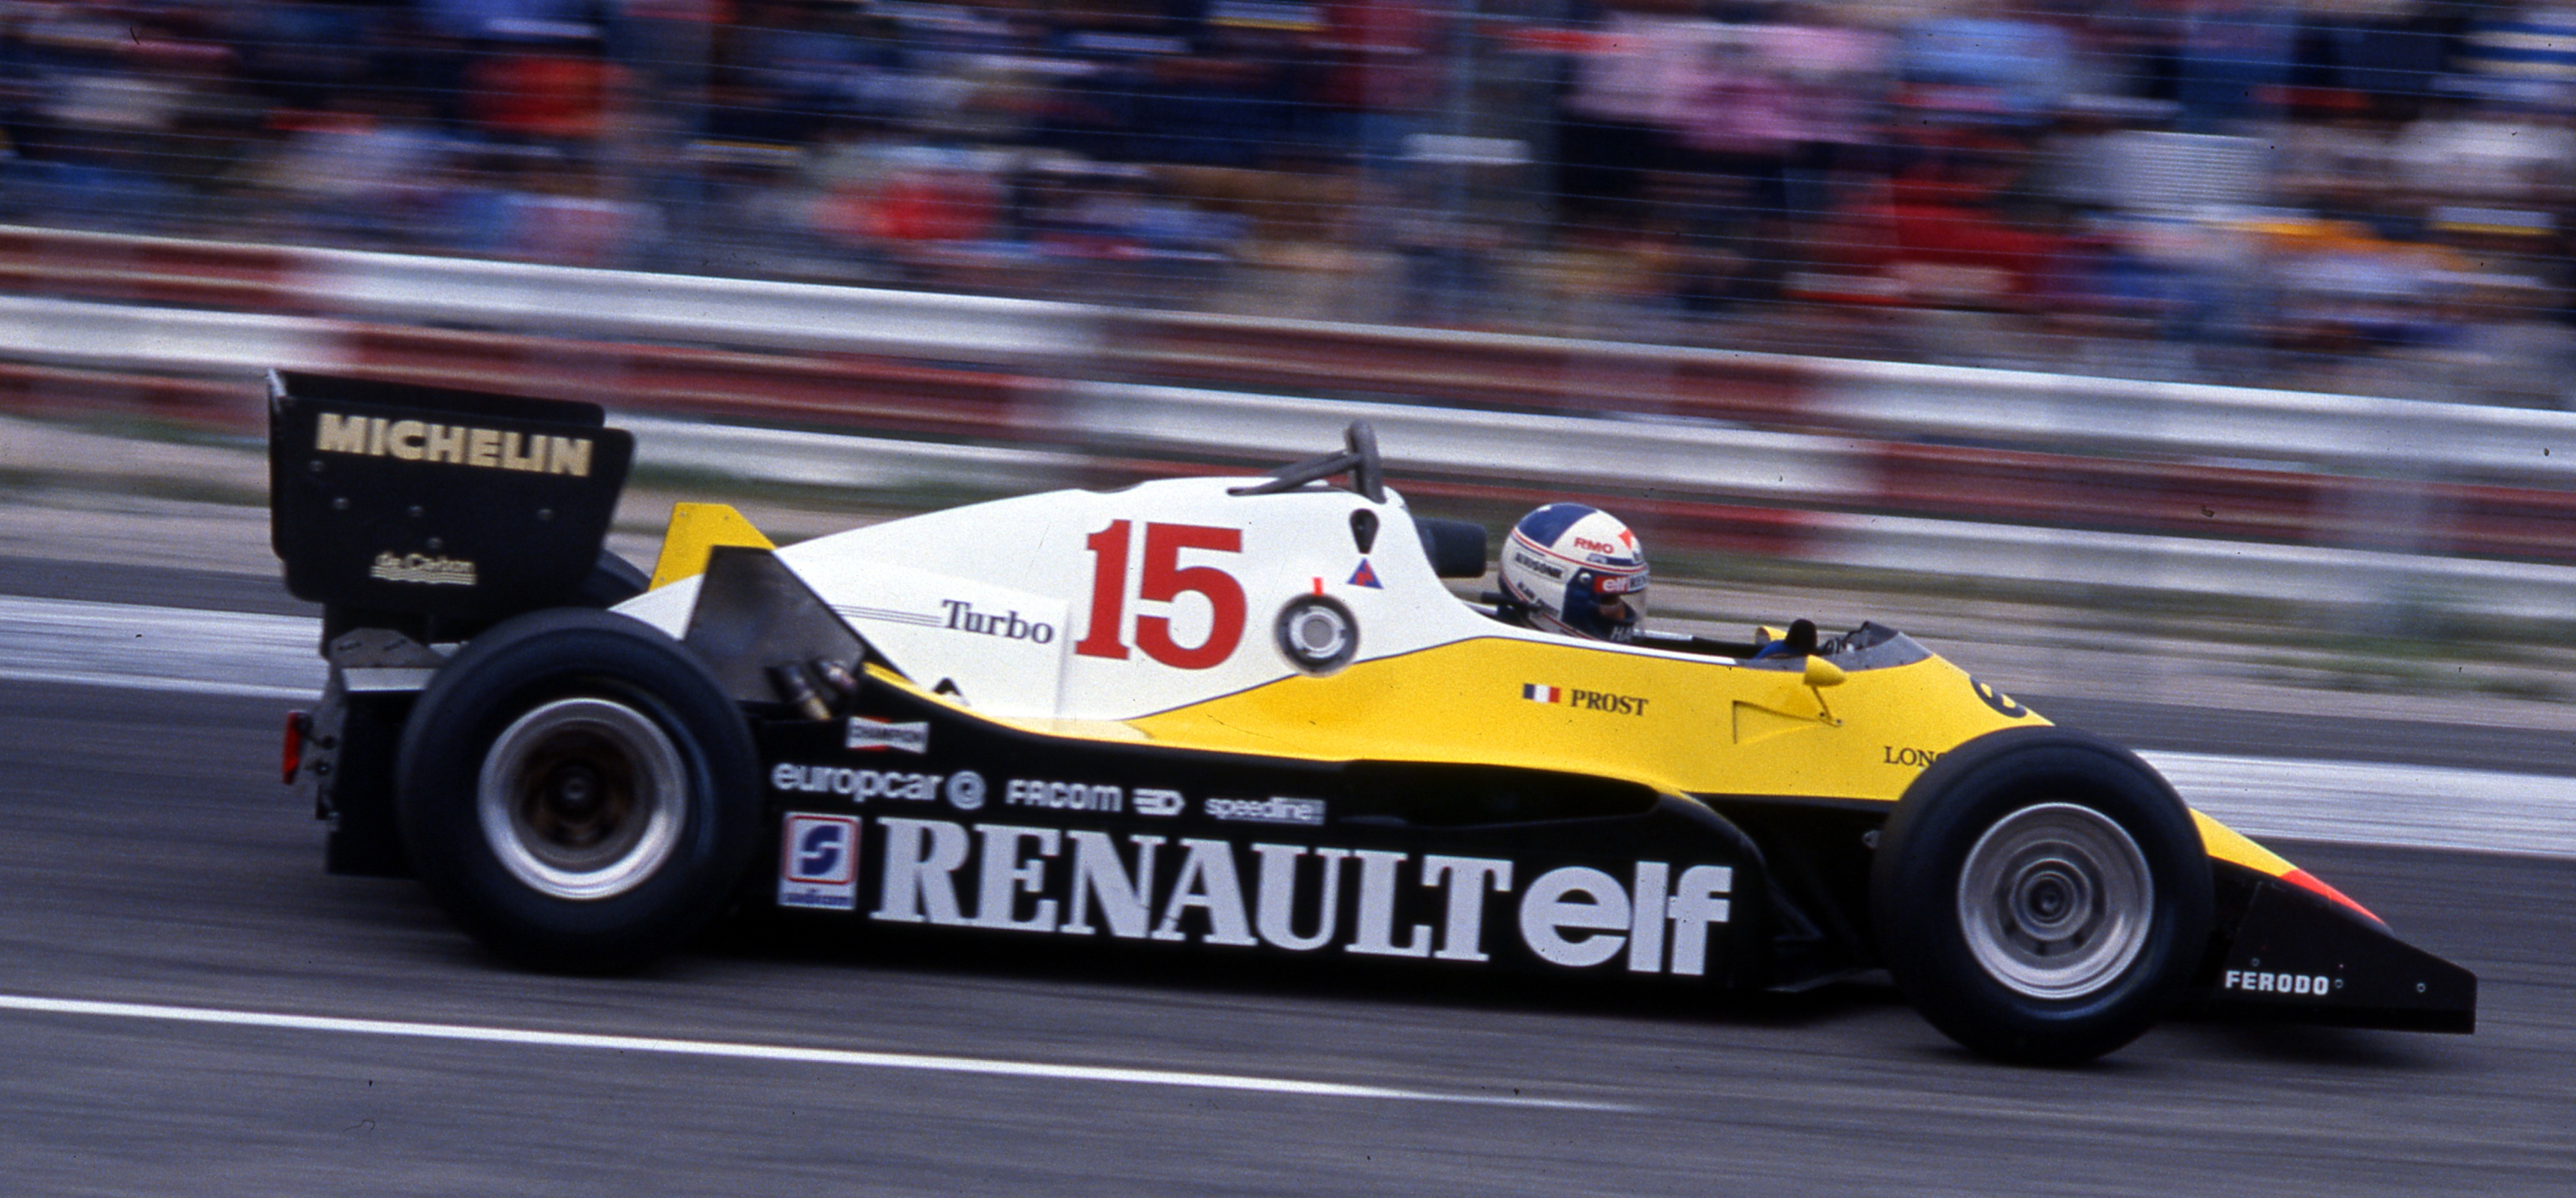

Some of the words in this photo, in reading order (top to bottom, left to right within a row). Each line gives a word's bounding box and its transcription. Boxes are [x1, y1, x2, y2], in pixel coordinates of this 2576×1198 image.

[317, 412, 594, 476] MICHELIN
[1574, 537, 1614, 554] RMO
[1076, 519, 1247, 670] 15
[1602, 577, 1629, 592] elf
[942, 599, 1054, 644] Turbo
[1571, 689, 1649, 716] PROST
[771, 763, 944, 803] europcar
[1006, 779, 1123, 812] FACOM
[1205, 797, 1320, 823] speedline
[869, 816, 1514, 962] RENAULT
[1519, 860, 1733, 976] elf
[2224, 970, 2329, 996] FERODO
